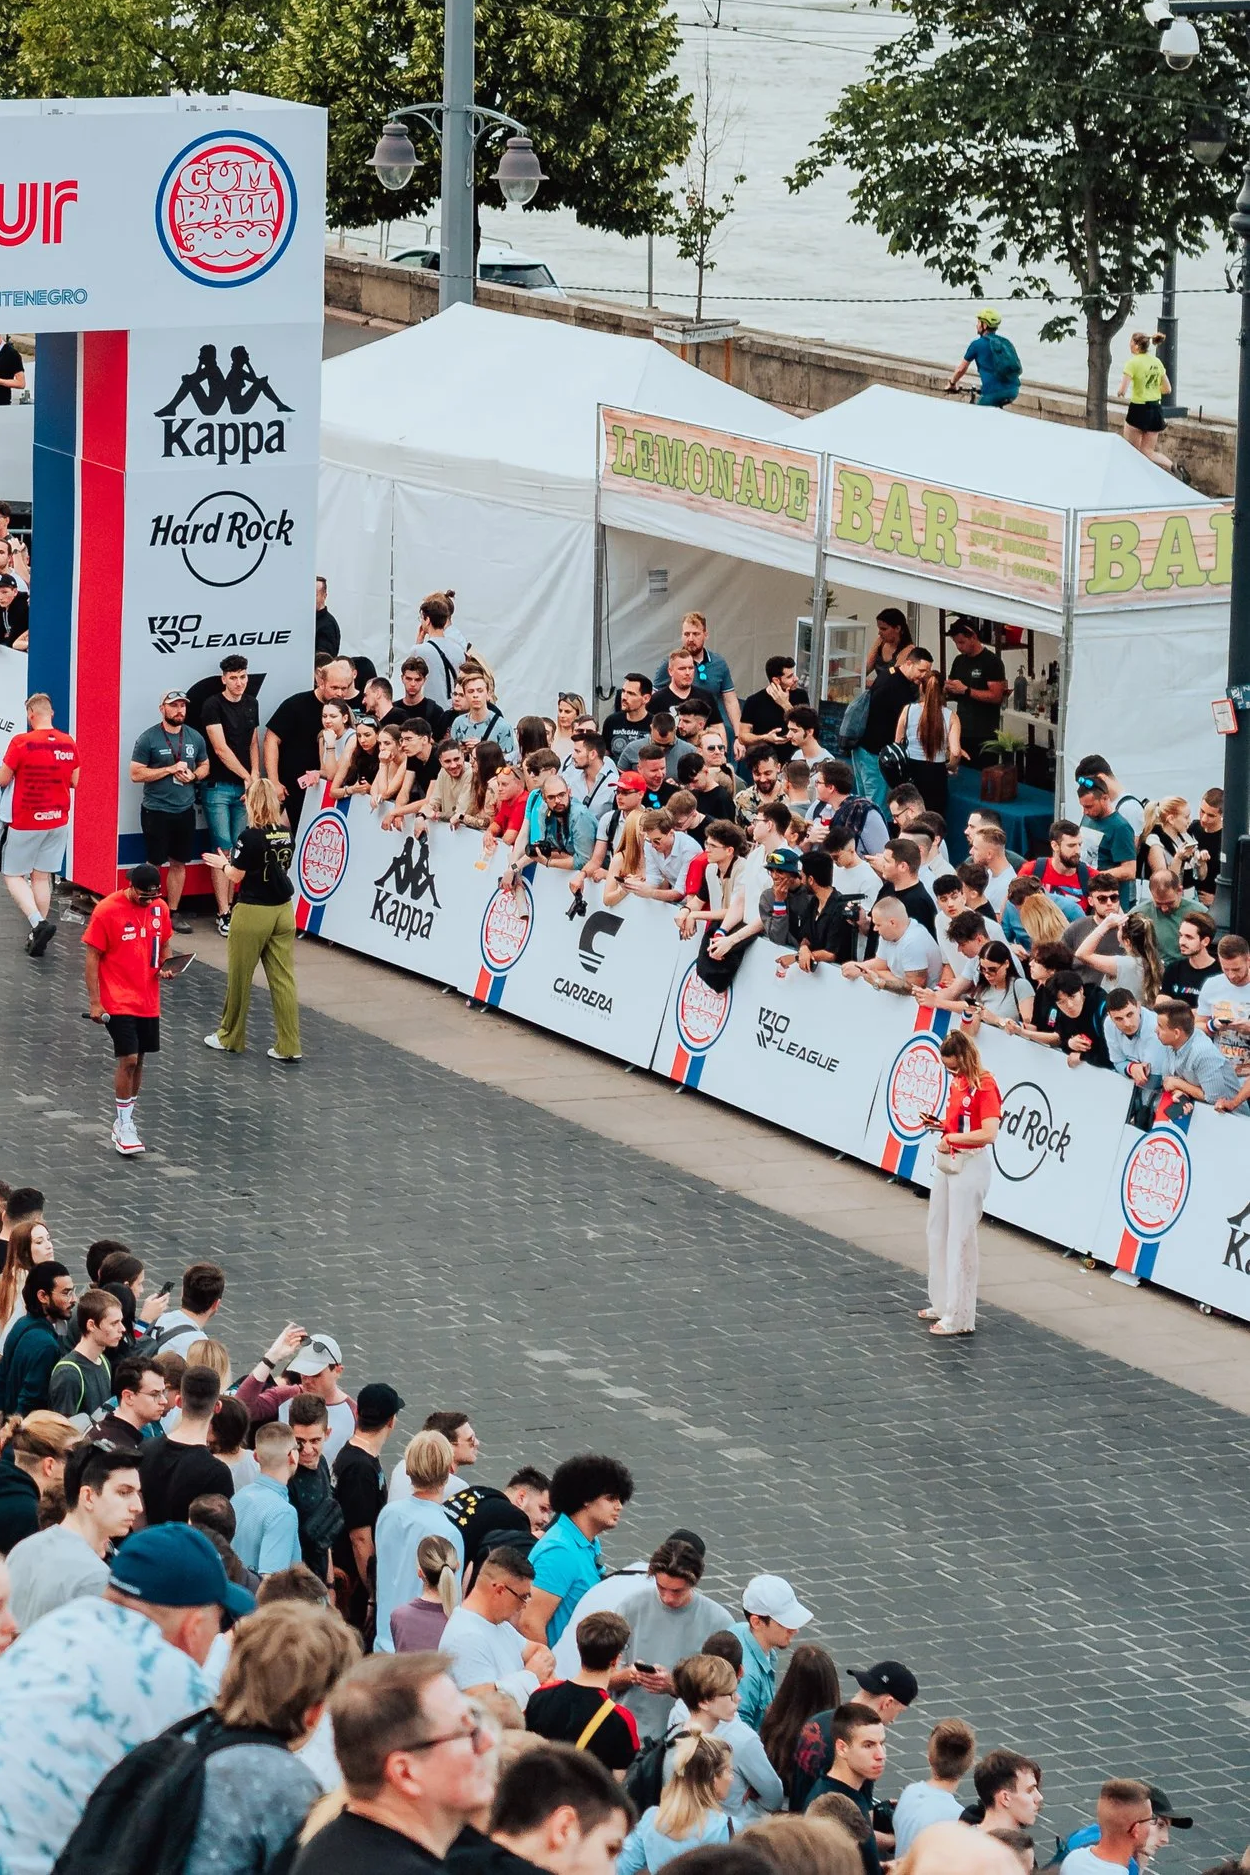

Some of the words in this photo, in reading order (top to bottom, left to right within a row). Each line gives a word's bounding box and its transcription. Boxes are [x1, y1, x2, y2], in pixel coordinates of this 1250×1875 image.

[179, 159, 276, 194] GUM
[176, 191, 277, 227] BALL
[178, 223, 275, 259] 3000
[161, 417, 287, 466] Kappa
[611, 424, 810, 522] LEMONADE
[149, 511, 225, 547] Hard
[226, 509, 296, 550] Rock
[835, 469, 963, 569] BAR
[147, 613, 203, 635] V10
[307, 843, 343, 866] BALL
[310, 825, 346, 851] GUM
[370, 888, 435, 942] Kappa
[553, 977, 613, 1014] CARRERA
[758, 1006, 790, 1034] V10
[999, 1105, 1026, 1137] rd
[1022, 1109, 1072, 1163] Rock
[1137, 1143, 1185, 1176] GUM
[1133, 1164, 1182, 1196] BALL
